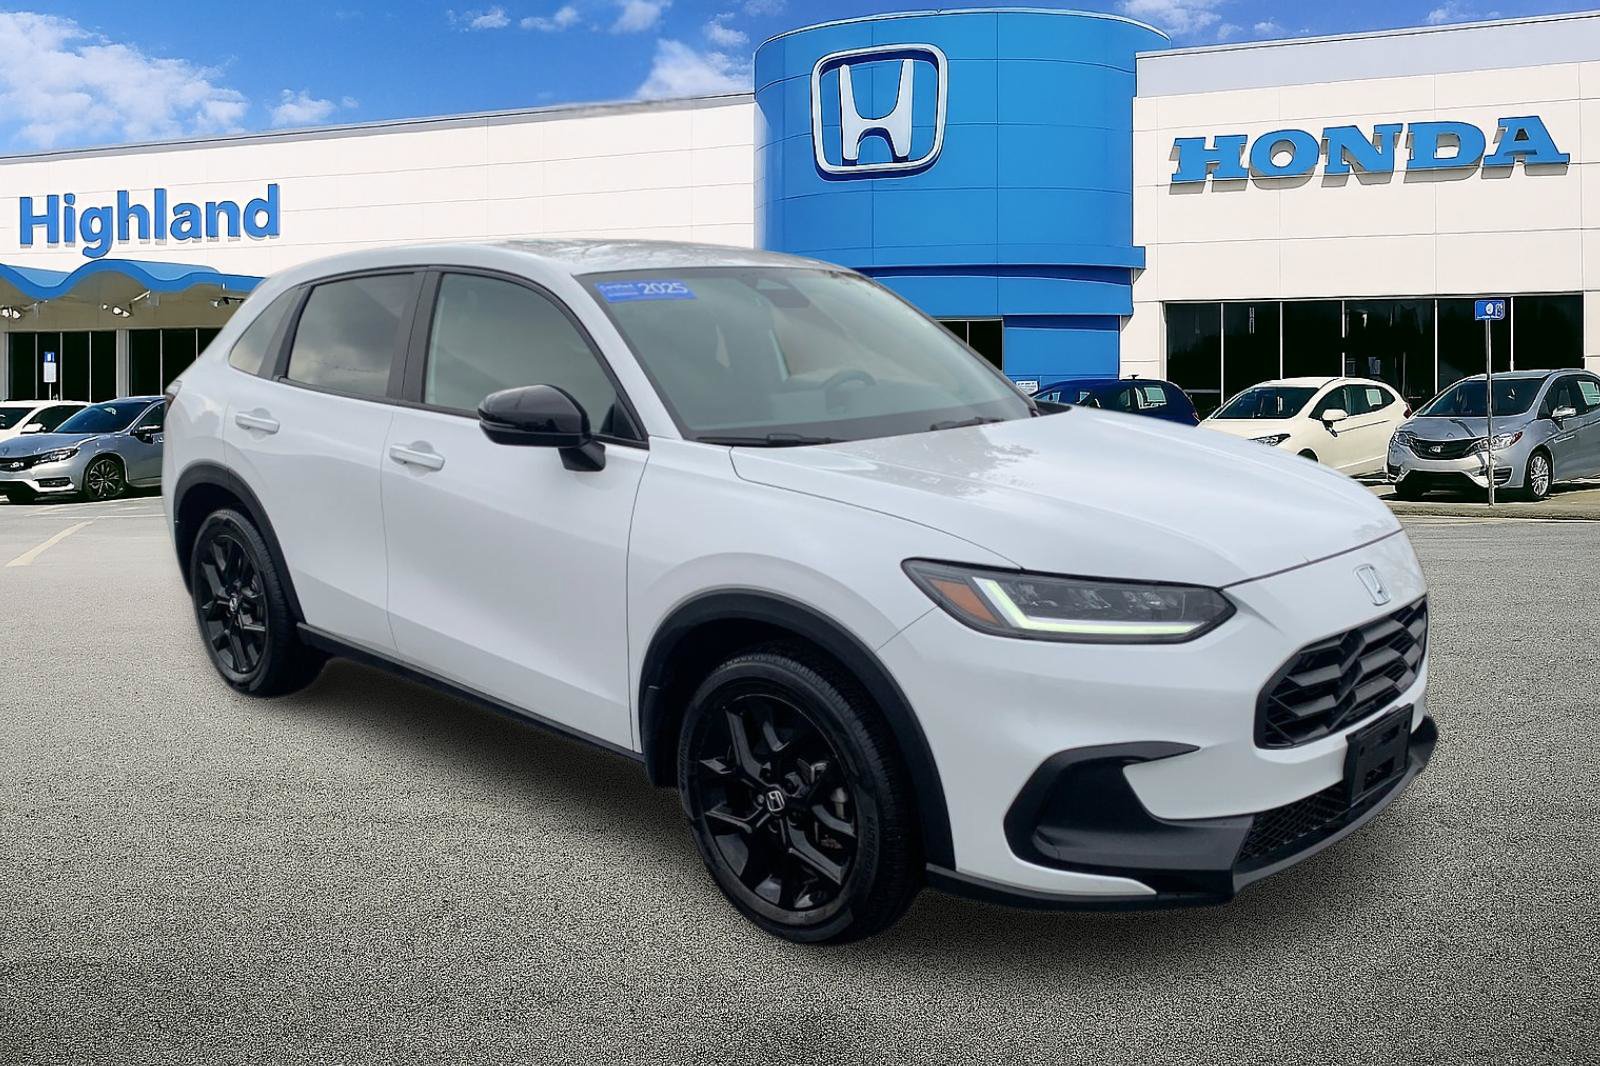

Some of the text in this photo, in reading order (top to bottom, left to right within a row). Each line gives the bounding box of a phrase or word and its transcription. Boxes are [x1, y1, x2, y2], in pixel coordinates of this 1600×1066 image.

[1171, 115, 1571, 184] HONDA
[19, 183, 280, 258] Highland
[637, 282, 688, 295] 2025
